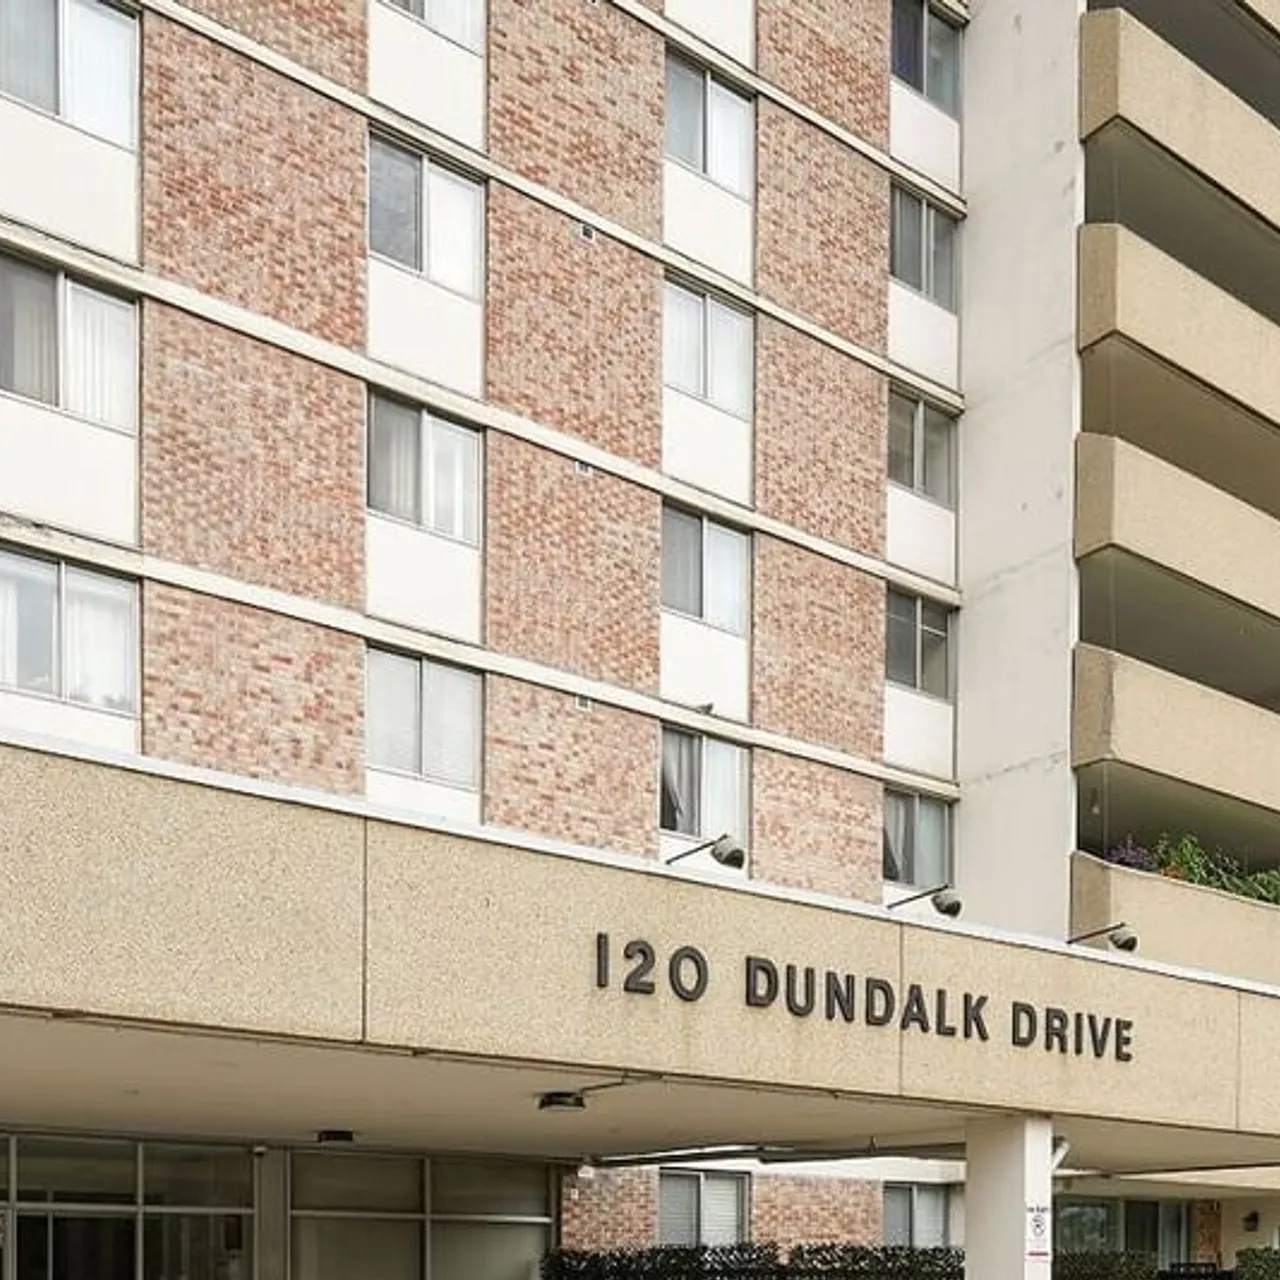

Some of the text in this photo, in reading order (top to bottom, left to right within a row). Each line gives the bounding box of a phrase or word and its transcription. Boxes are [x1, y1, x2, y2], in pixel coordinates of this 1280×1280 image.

[596, 932, 1134, 1062] 120 DUNDALK DRIVE
